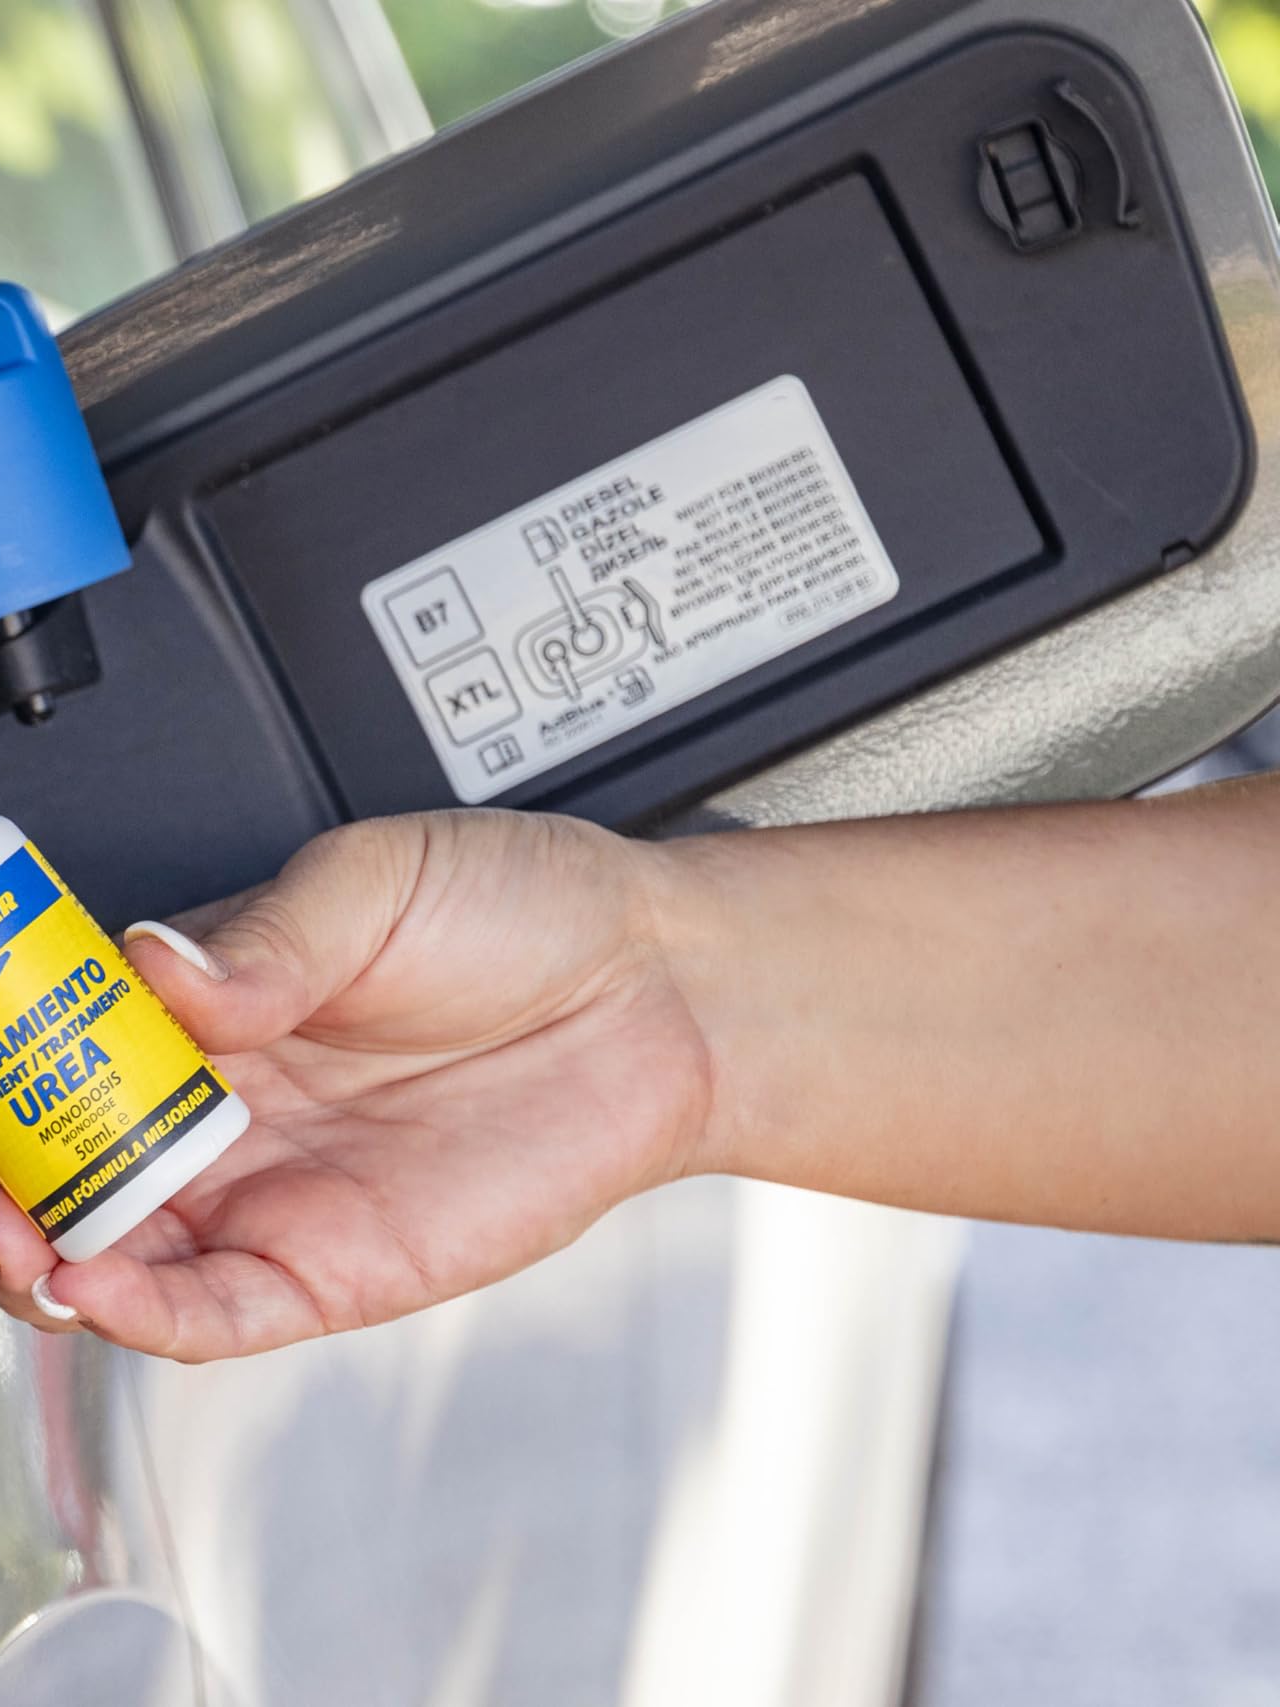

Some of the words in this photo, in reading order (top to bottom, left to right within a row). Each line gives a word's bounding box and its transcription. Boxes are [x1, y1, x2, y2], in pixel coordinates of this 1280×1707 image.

[559, 472, 641, 525] DIESEL
[568, 484, 666, 544] GAZOLE
[413, 599, 454, 636] B7
[444, 674, 503, 718] XTL
[37, 978, 131, 1062] TRATAMENTO
[9, 1037, 112, 1127] UREA
[39, 1071, 122, 1145] MONODOSIS
[62, 1097, 116, 1146] MONODOSE
[75, 1125, 116, 1161] 50ml.
[39, 1197, 76, 1229] NUEVA
[72, 1140, 146, 1206] FÓRMULA
[144, 1084, 212, 1149] MEJORADA
